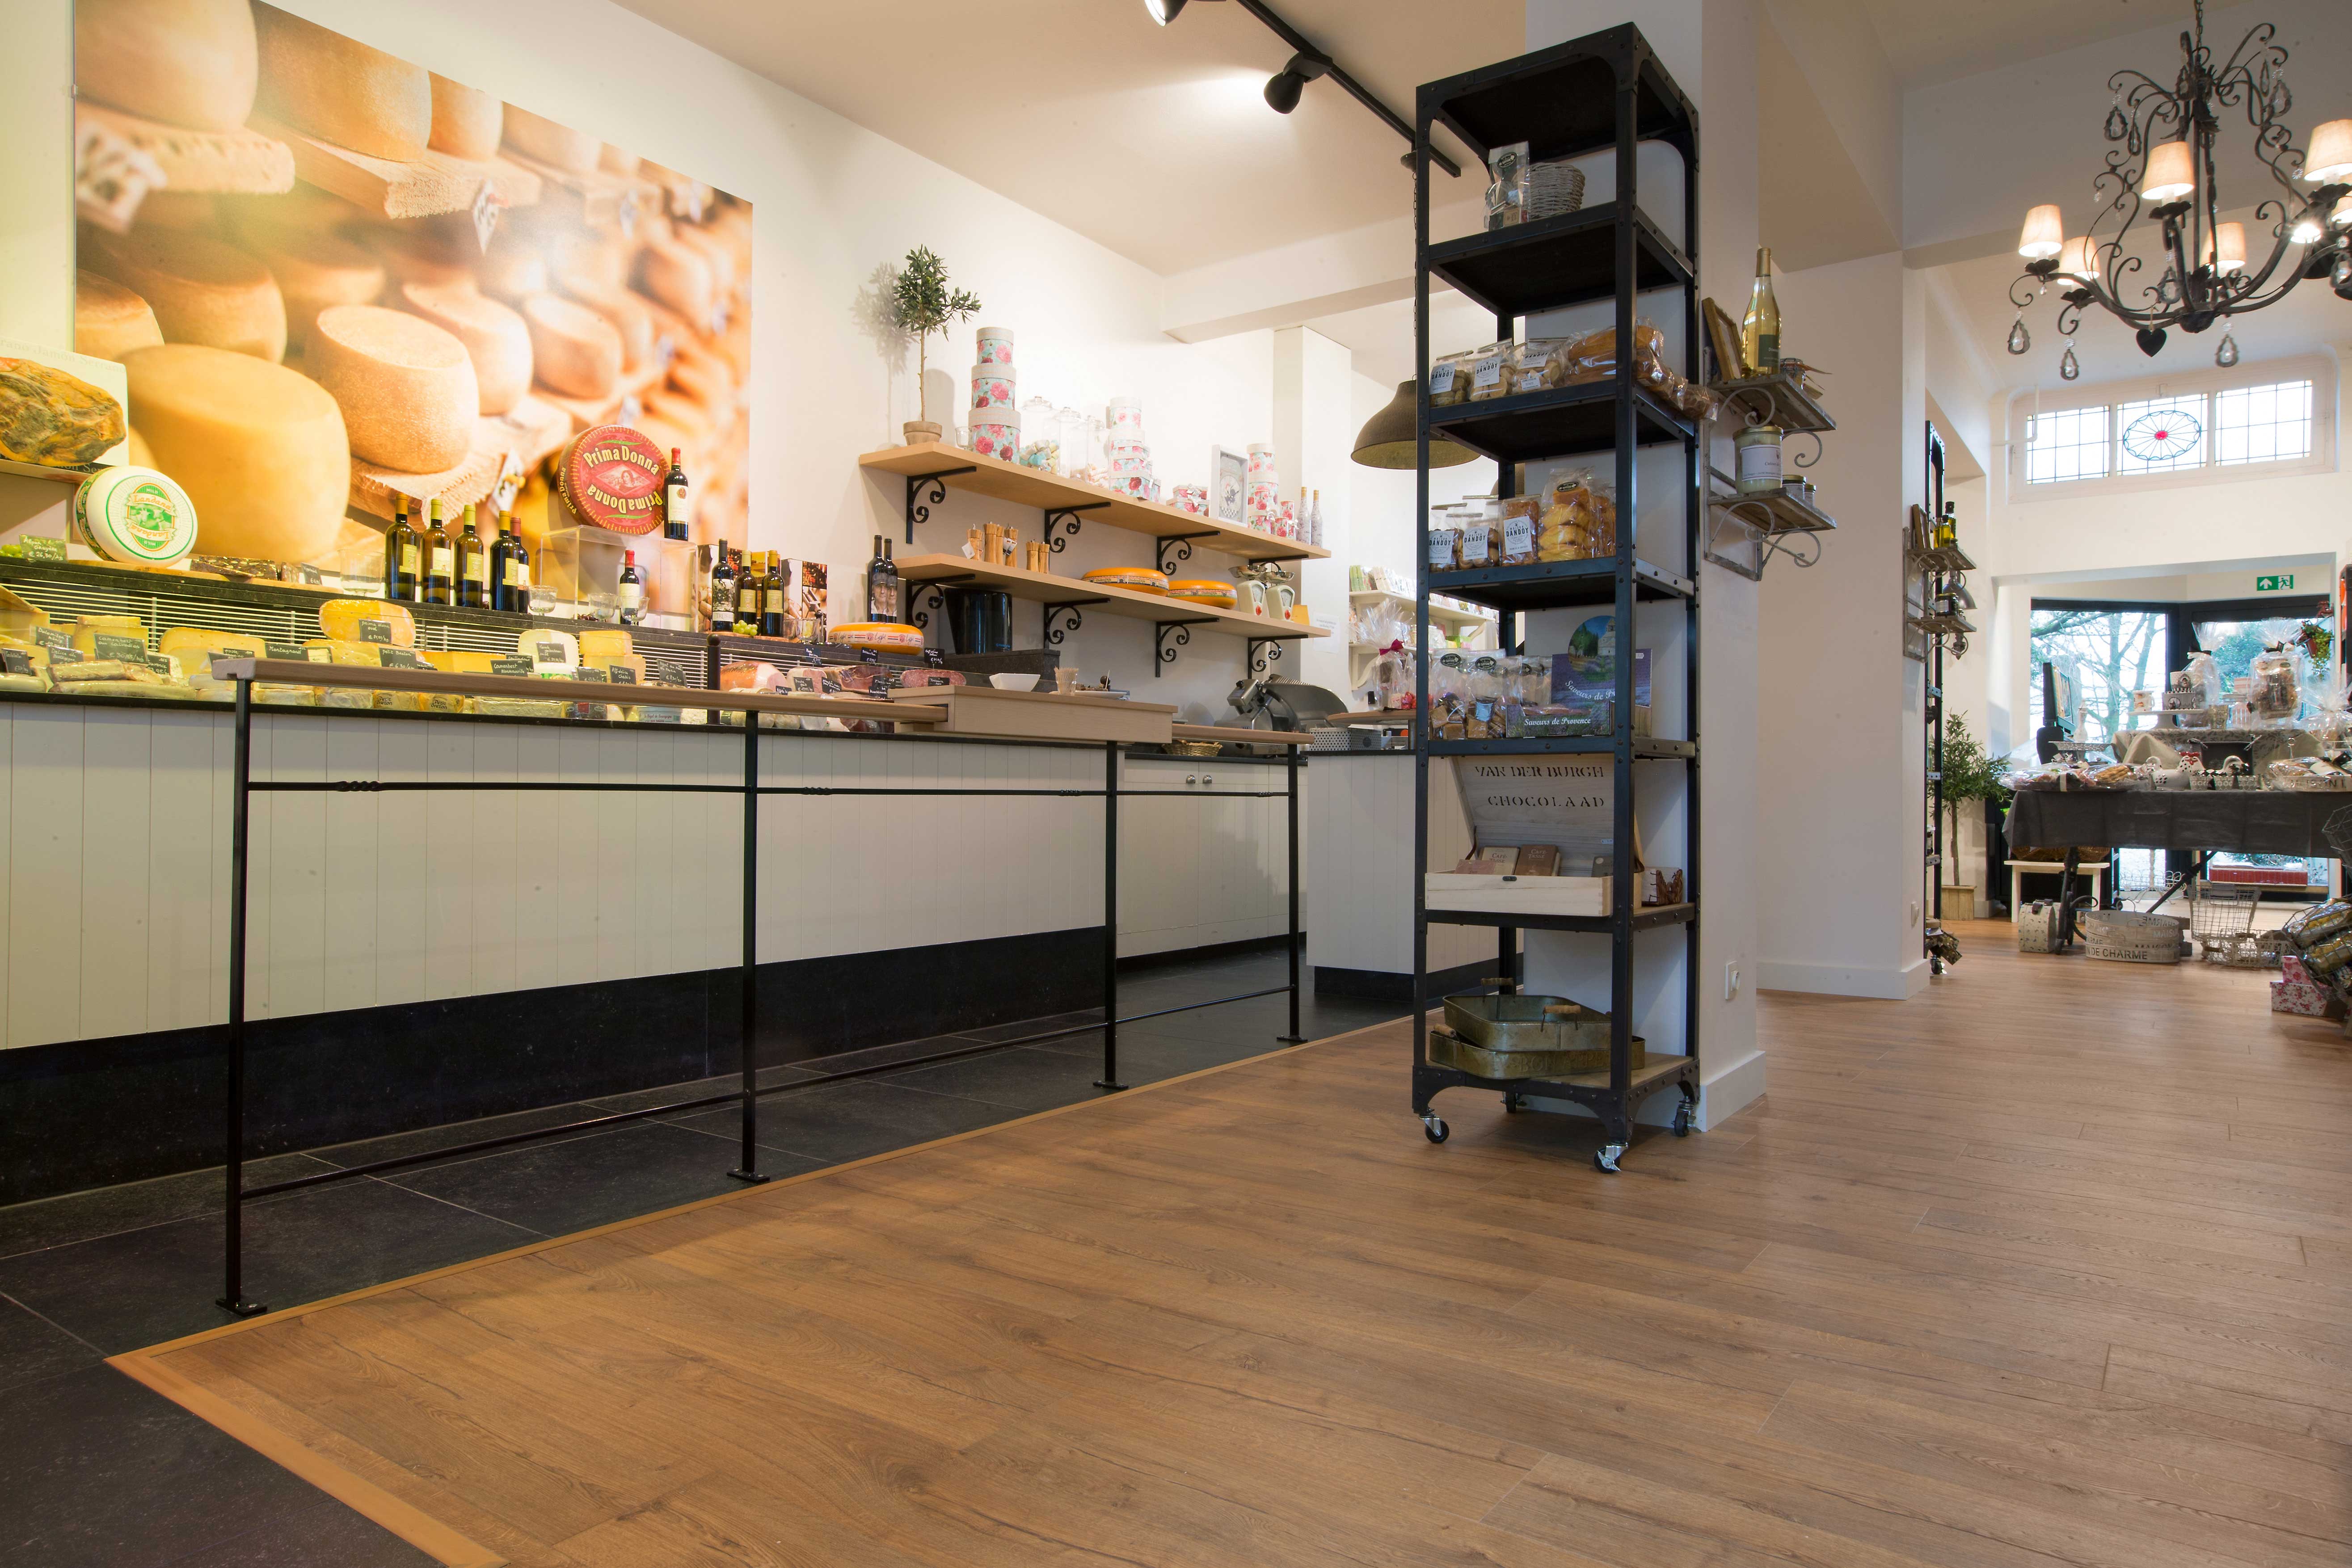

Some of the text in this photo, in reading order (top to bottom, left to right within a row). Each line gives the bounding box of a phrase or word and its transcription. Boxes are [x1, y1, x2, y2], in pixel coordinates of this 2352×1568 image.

[1476, 363, 1498, 374] DANDOY
[1431, 371, 1453, 379] DANDOY
[583, 446, 660, 476] Prima Donna
[134, 494, 172, 509] Landana
[587, 484, 627, 514] Donna
[130, 524, 169, 539] Landana
[1506, 528, 1529, 537] DANDOY
[1565, 680, 1591, 700] Saveurs
[1475, 766, 1604, 777] VAN DER BURGH
[1488, 796, 1604, 807] CHOCOLAAD
[2091, 948, 2147, 960] DE CHARME
